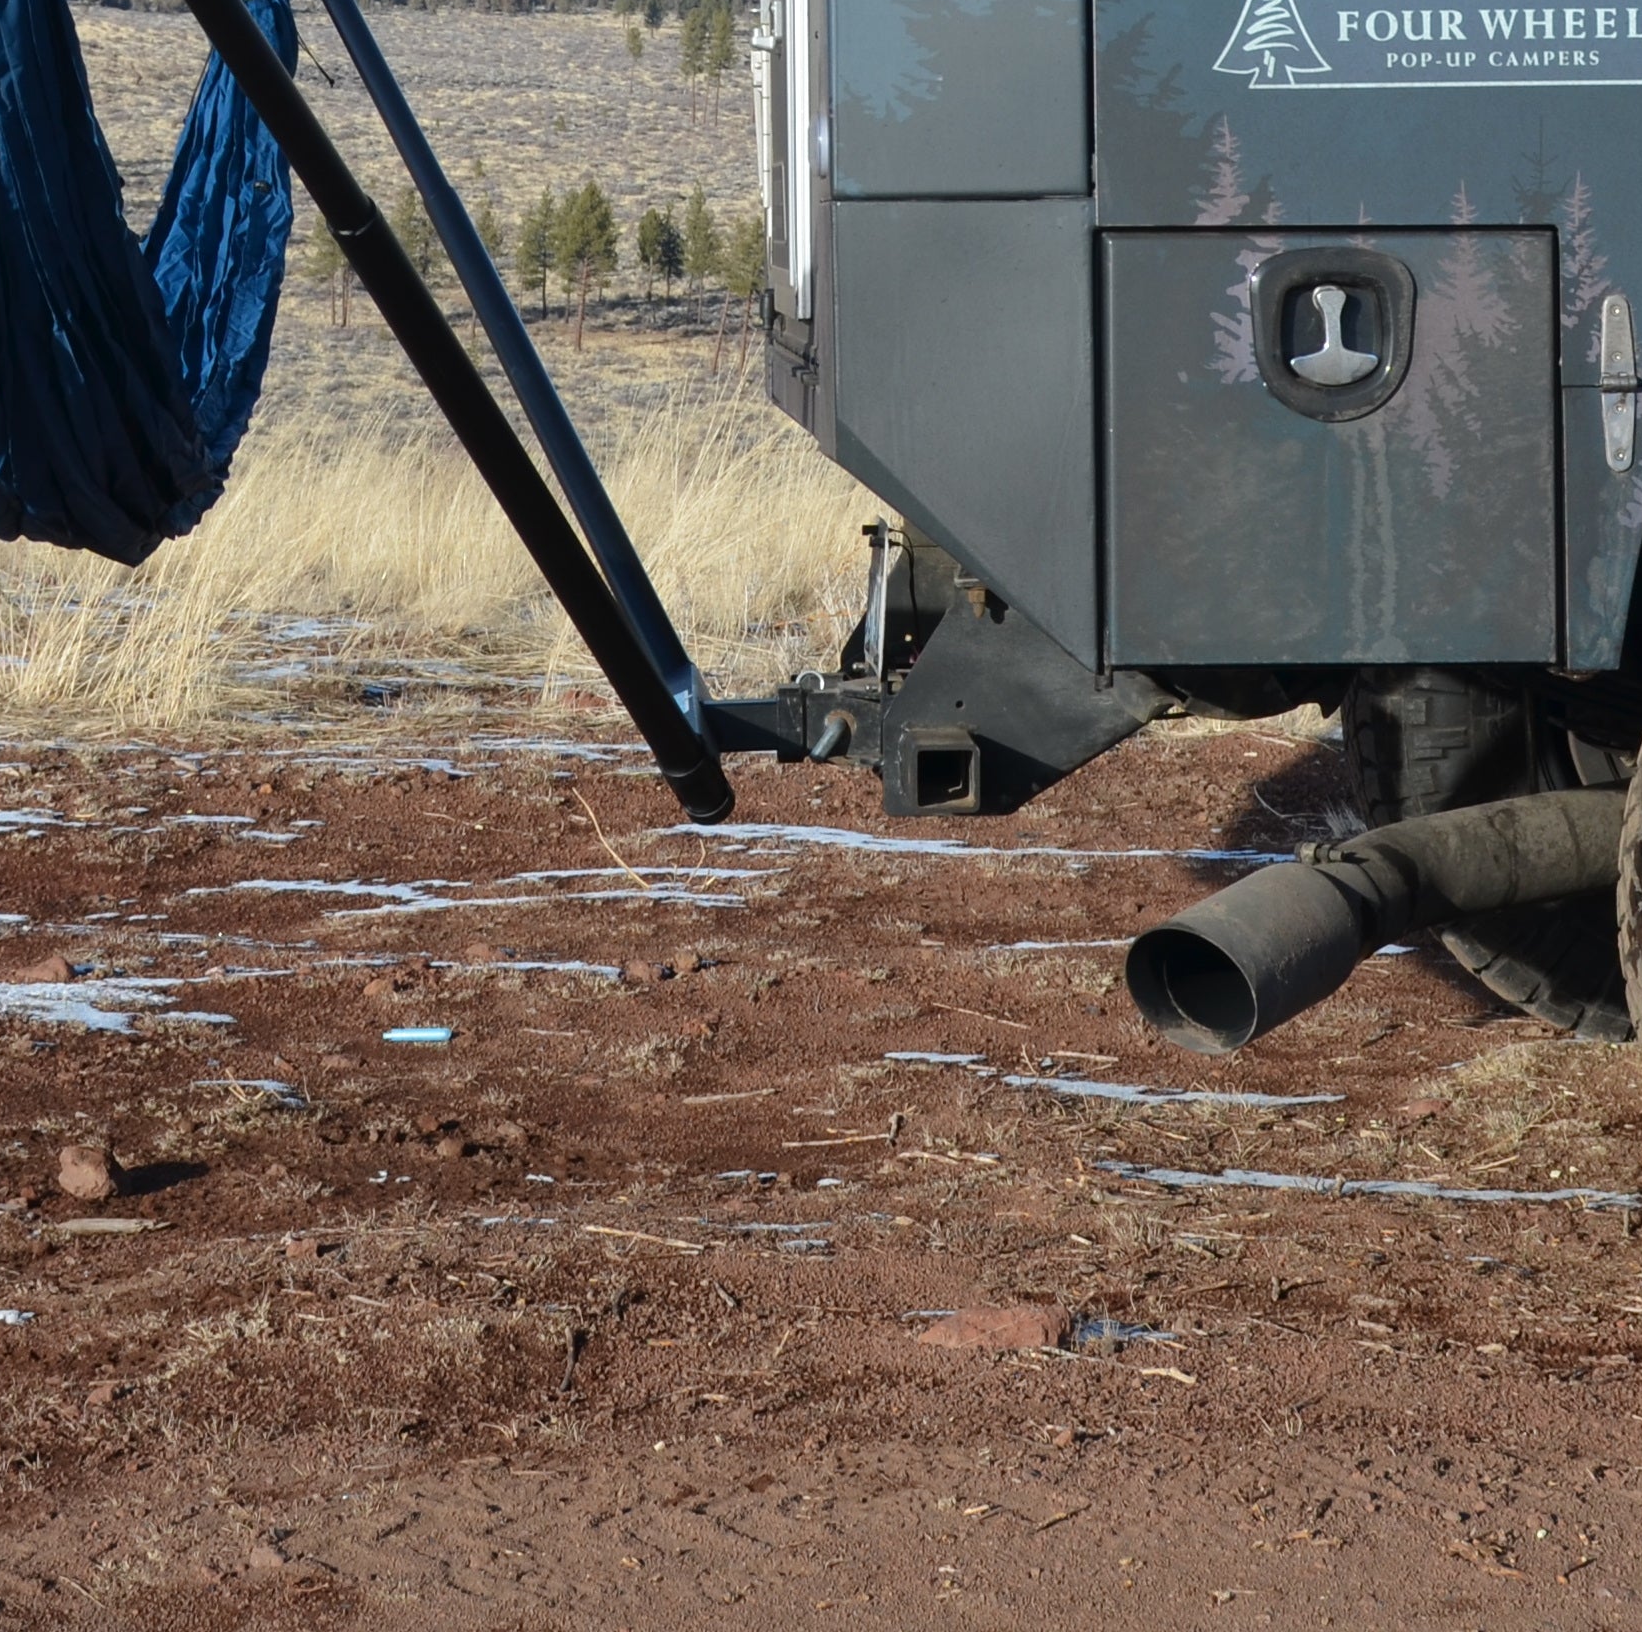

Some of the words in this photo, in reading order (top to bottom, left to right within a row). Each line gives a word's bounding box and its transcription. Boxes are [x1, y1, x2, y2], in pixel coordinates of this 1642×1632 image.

[1336, 8, 1467, 42] FOUR
[1386, 52, 1477, 69] POP-UP
[1488, 50, 1601, 68] CAMPERS
